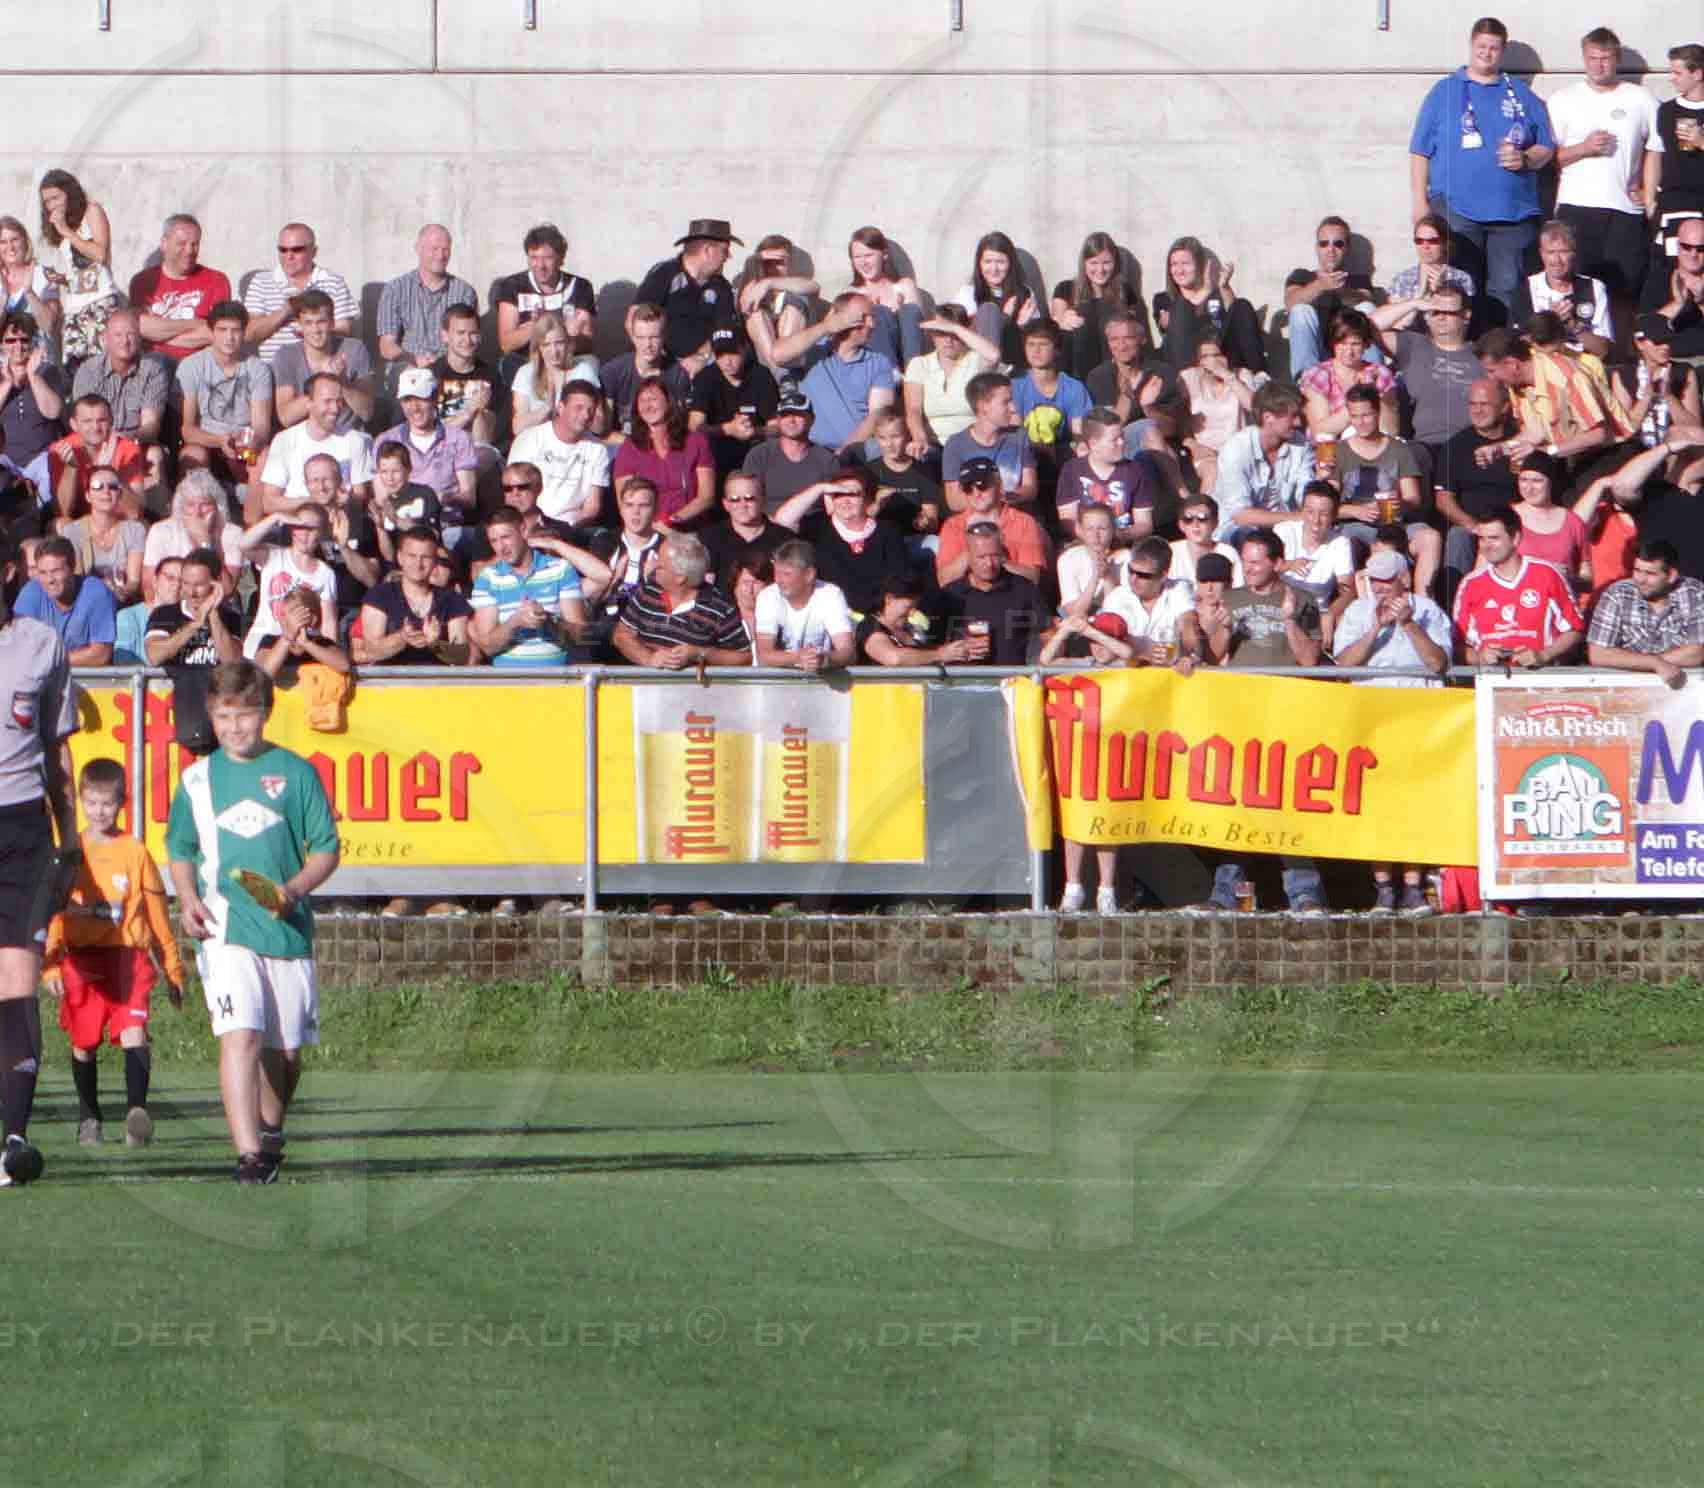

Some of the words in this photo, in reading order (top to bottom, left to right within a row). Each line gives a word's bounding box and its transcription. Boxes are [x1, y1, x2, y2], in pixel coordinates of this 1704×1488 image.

[112, 692, 482, 842] Mauer
[666, 711, 730, 859] Murauer
[767, 724, 820, 850] Murauer
[1528, 757, 1601, 802] BAU
[1089, 816, 1153, 837] Rein
[1161, 815, 1209, 840] das
[1225, 822, 1305, 848] Beste
[1503, 794, 1623, 836] RING
[1641, 830, 1677, 849] Am
